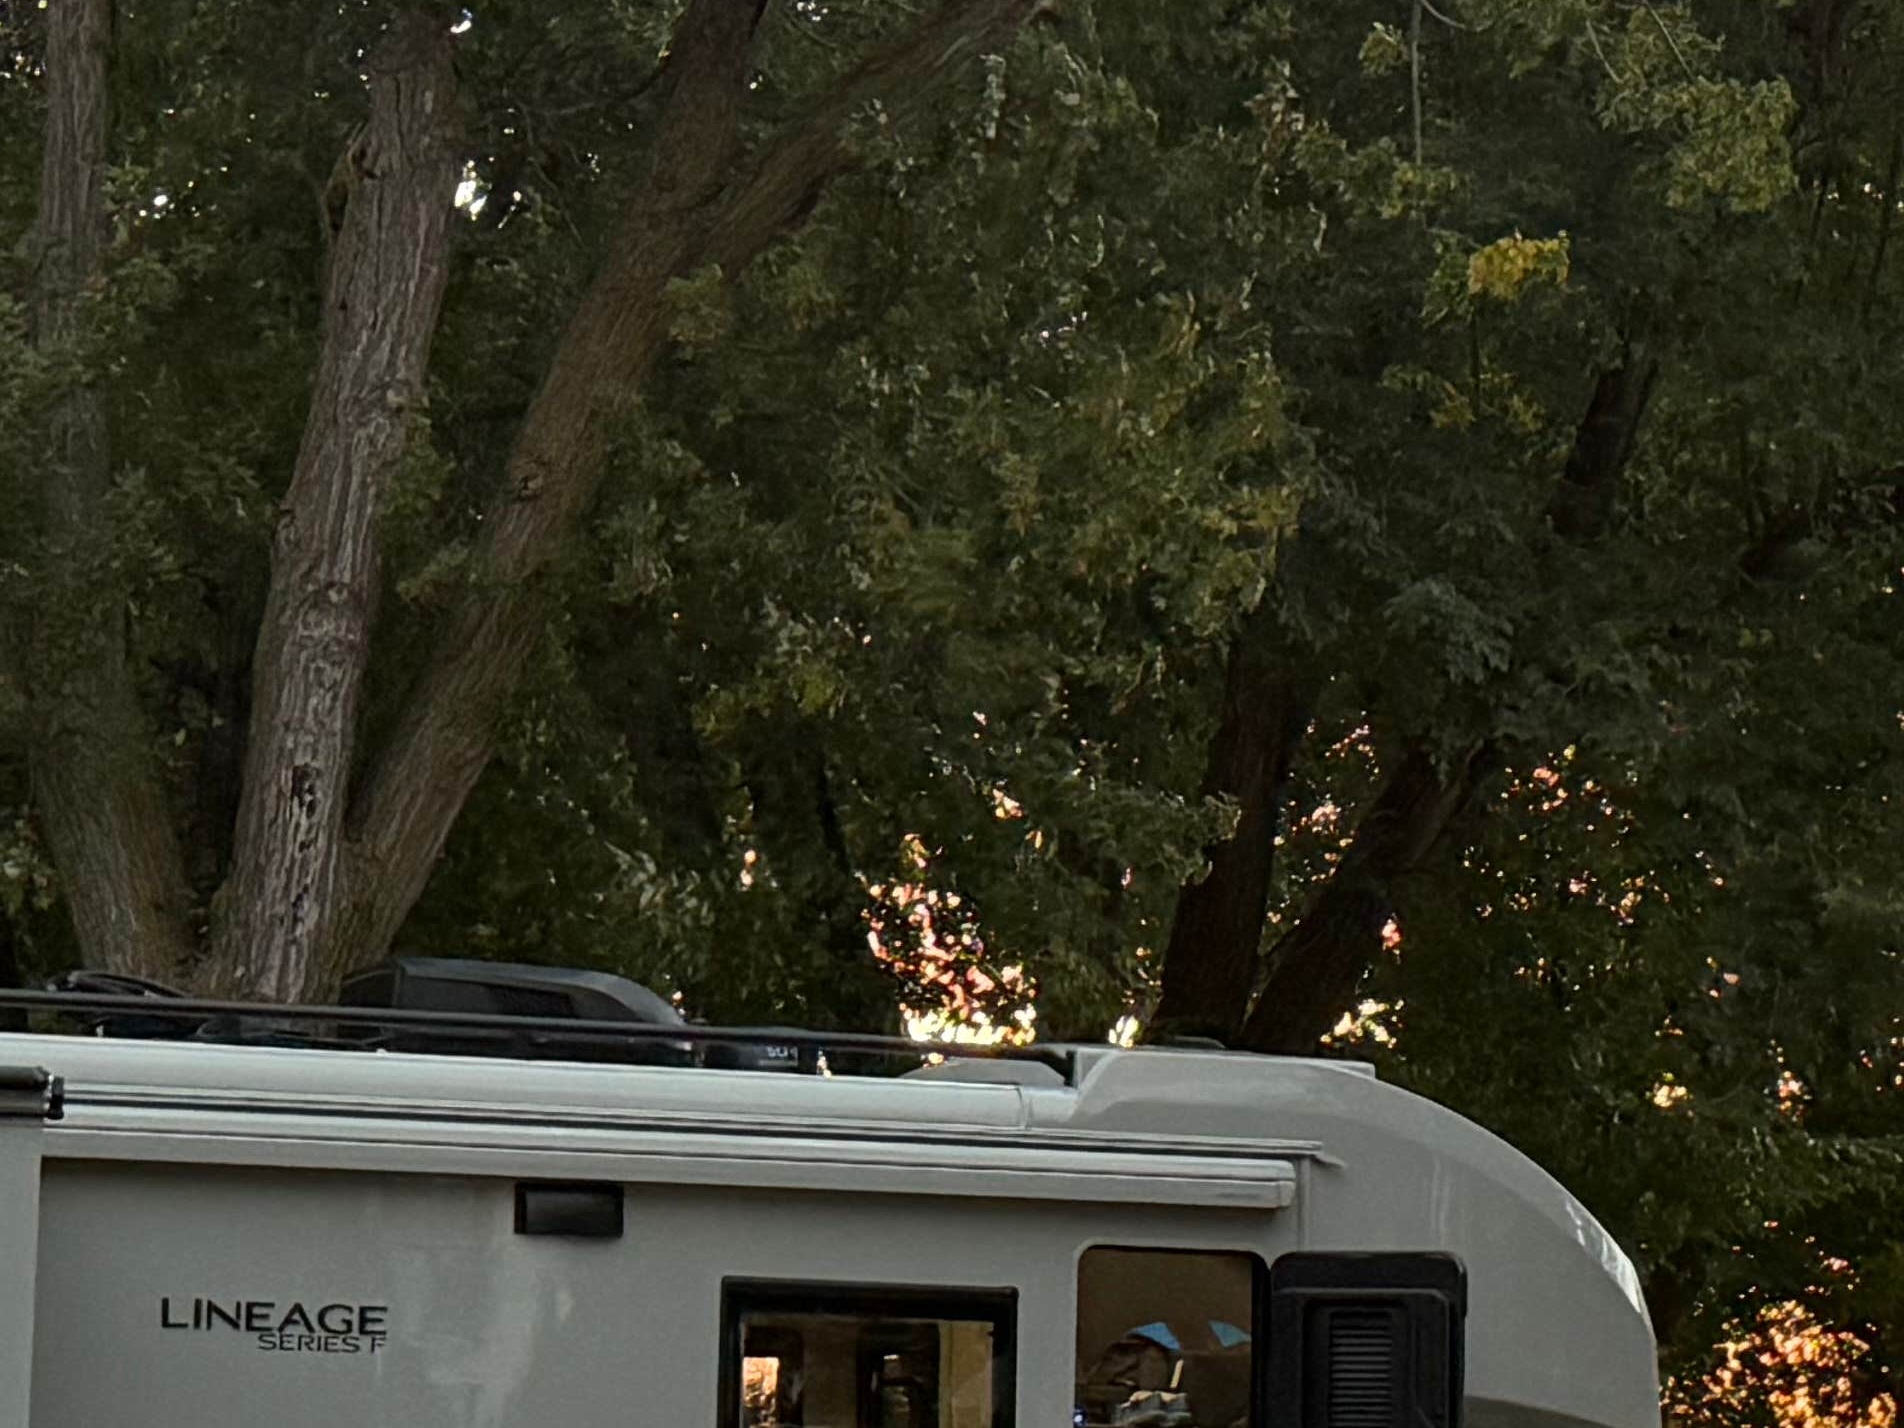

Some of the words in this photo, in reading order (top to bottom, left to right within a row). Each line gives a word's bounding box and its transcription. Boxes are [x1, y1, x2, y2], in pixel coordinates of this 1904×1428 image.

[160, 1297, 388, 1336] LINEAGE
[257, 1333, 361, 1354] SERIES
[370, 1336, 387, 1354] F
